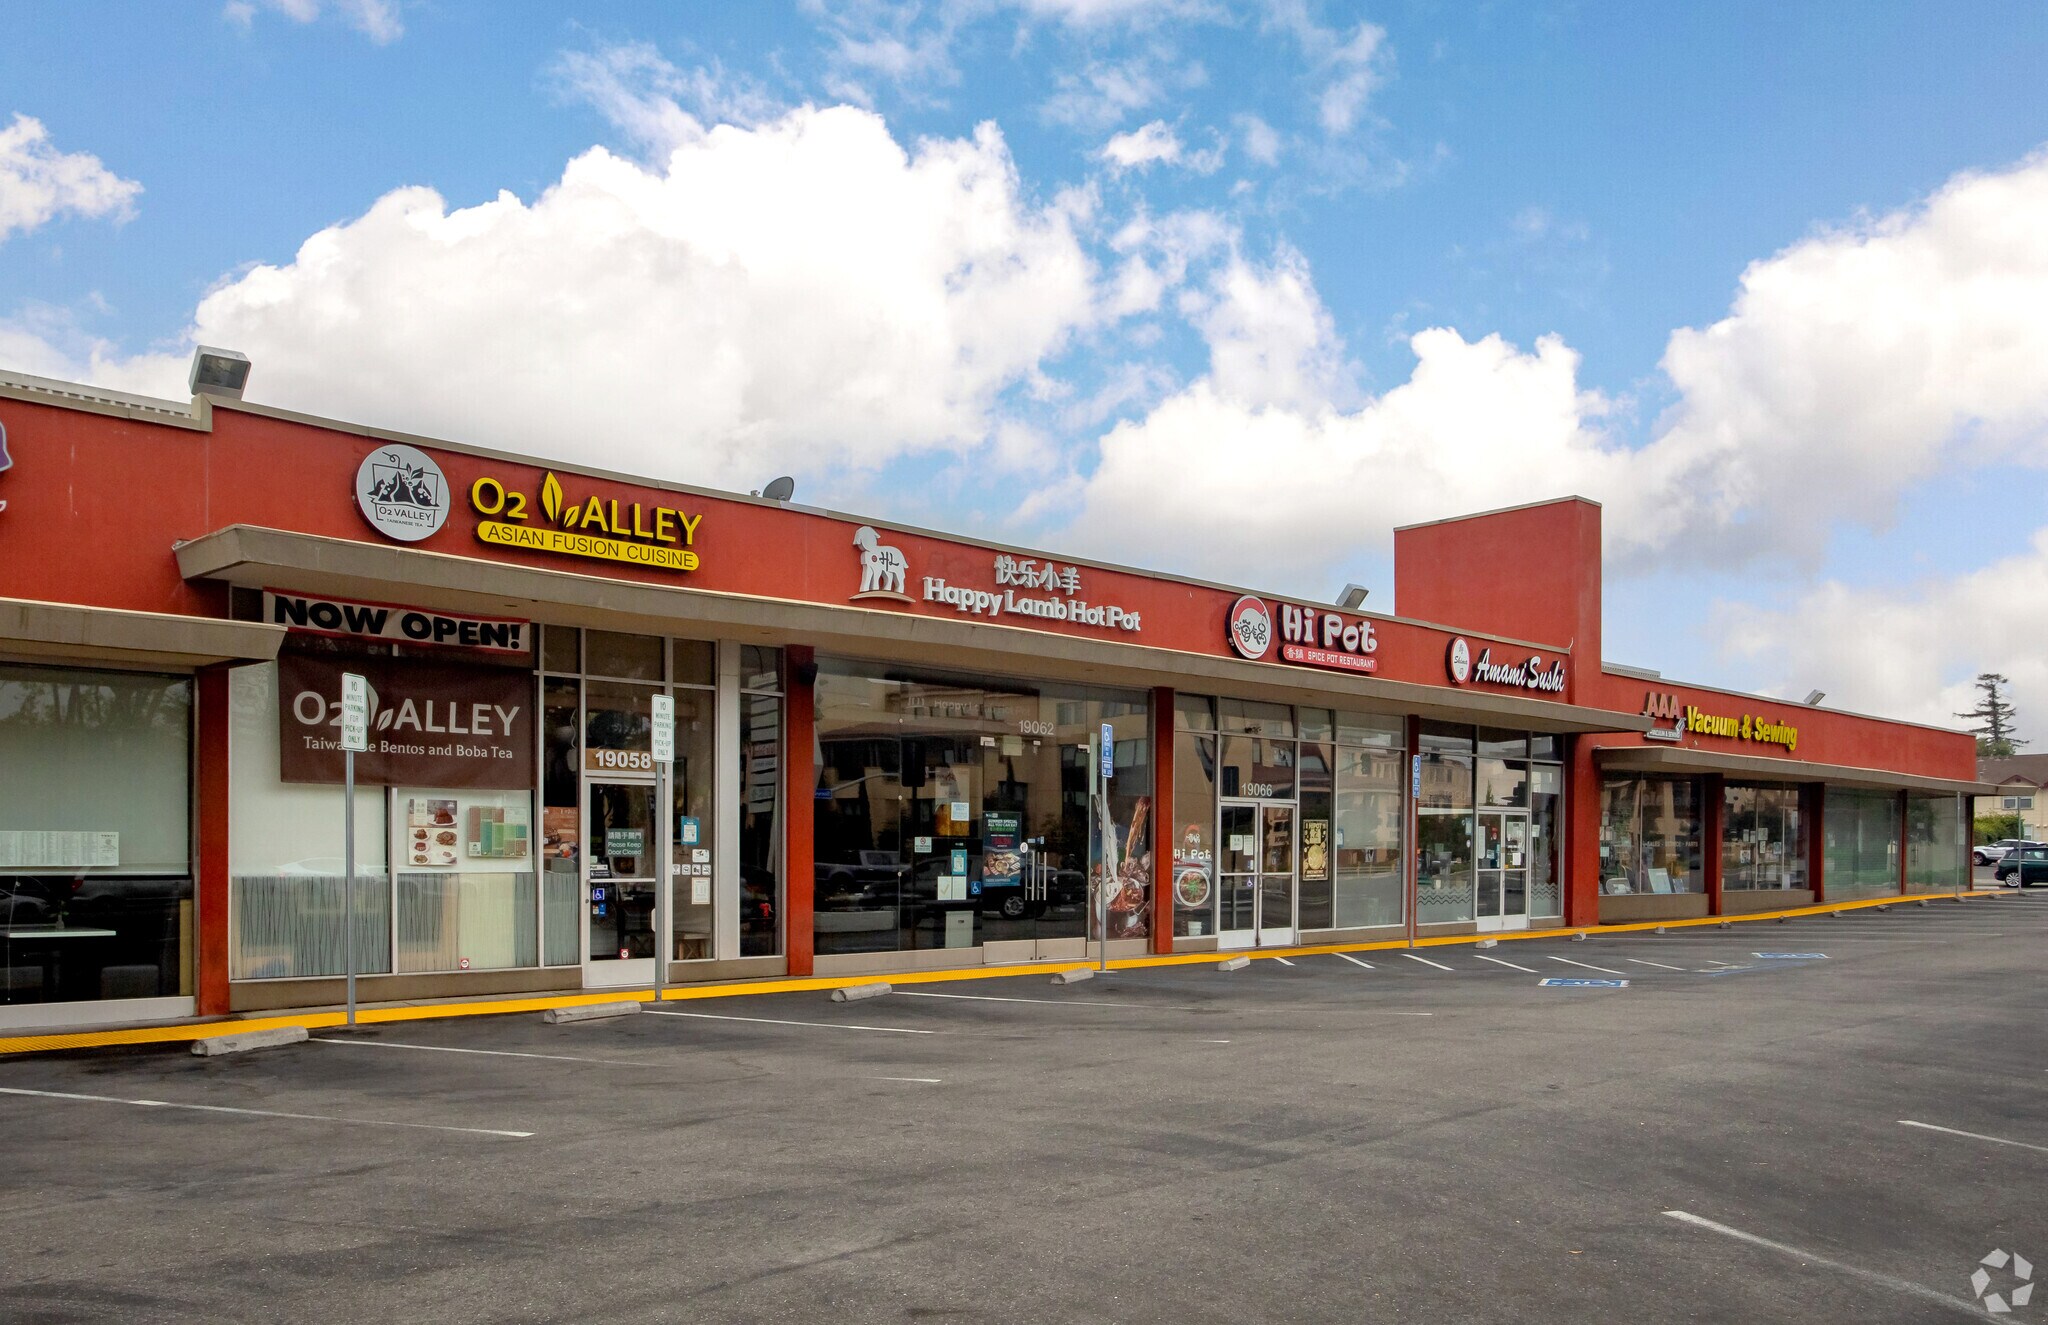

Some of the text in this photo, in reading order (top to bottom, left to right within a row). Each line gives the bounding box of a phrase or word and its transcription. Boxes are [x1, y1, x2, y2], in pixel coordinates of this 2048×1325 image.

[471, 477, 529, 519] O2
[379, 506, 432, 521] O2 VALLEY
[487, 524, 694, 568] ASIAN FUSION CUISINE
[993, 554, 1082, 596] 快乐小羊
[922, 576, 1141, 632] Happy Lamb Hot Pot
[274, 595, 521, 650] NOW OPEN!
[1282, 604, 1378, 654] Hi Pot
[1307, 651, 1375, 669] SPICE POT RESTAURANT
[1475, 648, 1565, 692] Amami Sushi
[351, 681, 358, 692] 10
[346, 693, 362, 703] MINUTE
[1647, 691, 1681, 719] AAA
[345, 703, 363, 713] PARKING
[660, 701, 667, 711] 10
[349, 714, 358, 723] FOR
[655, 712, 671, 720] MINUTE
[345, 724, 363, 734] PICK-UP
[654, 721, 672, 730] PARKING
[1019, 719, 1055, 736] 19062
[1687, 705, 1798, 751] Vacuum & Sewing
[347, 735, 360, 743] ONLY
[658, 730, 667, 738] FOR
[380, 740, 425, 755] Bentos
[428, 743, 452, 756] and
[456, 745, 488, 758] Boba
[491, 746, 513, 759] Tea
[655, 739, 672, 747] PICK-UP
[595, 750, 652, 769] 19058
[657, 748, 669, 756] ONLY
[1241, 782, 1273, 797] 19066
[627, 841, 642, 849] Keep
[1174, 848, 1212, 860] Hi Pot
